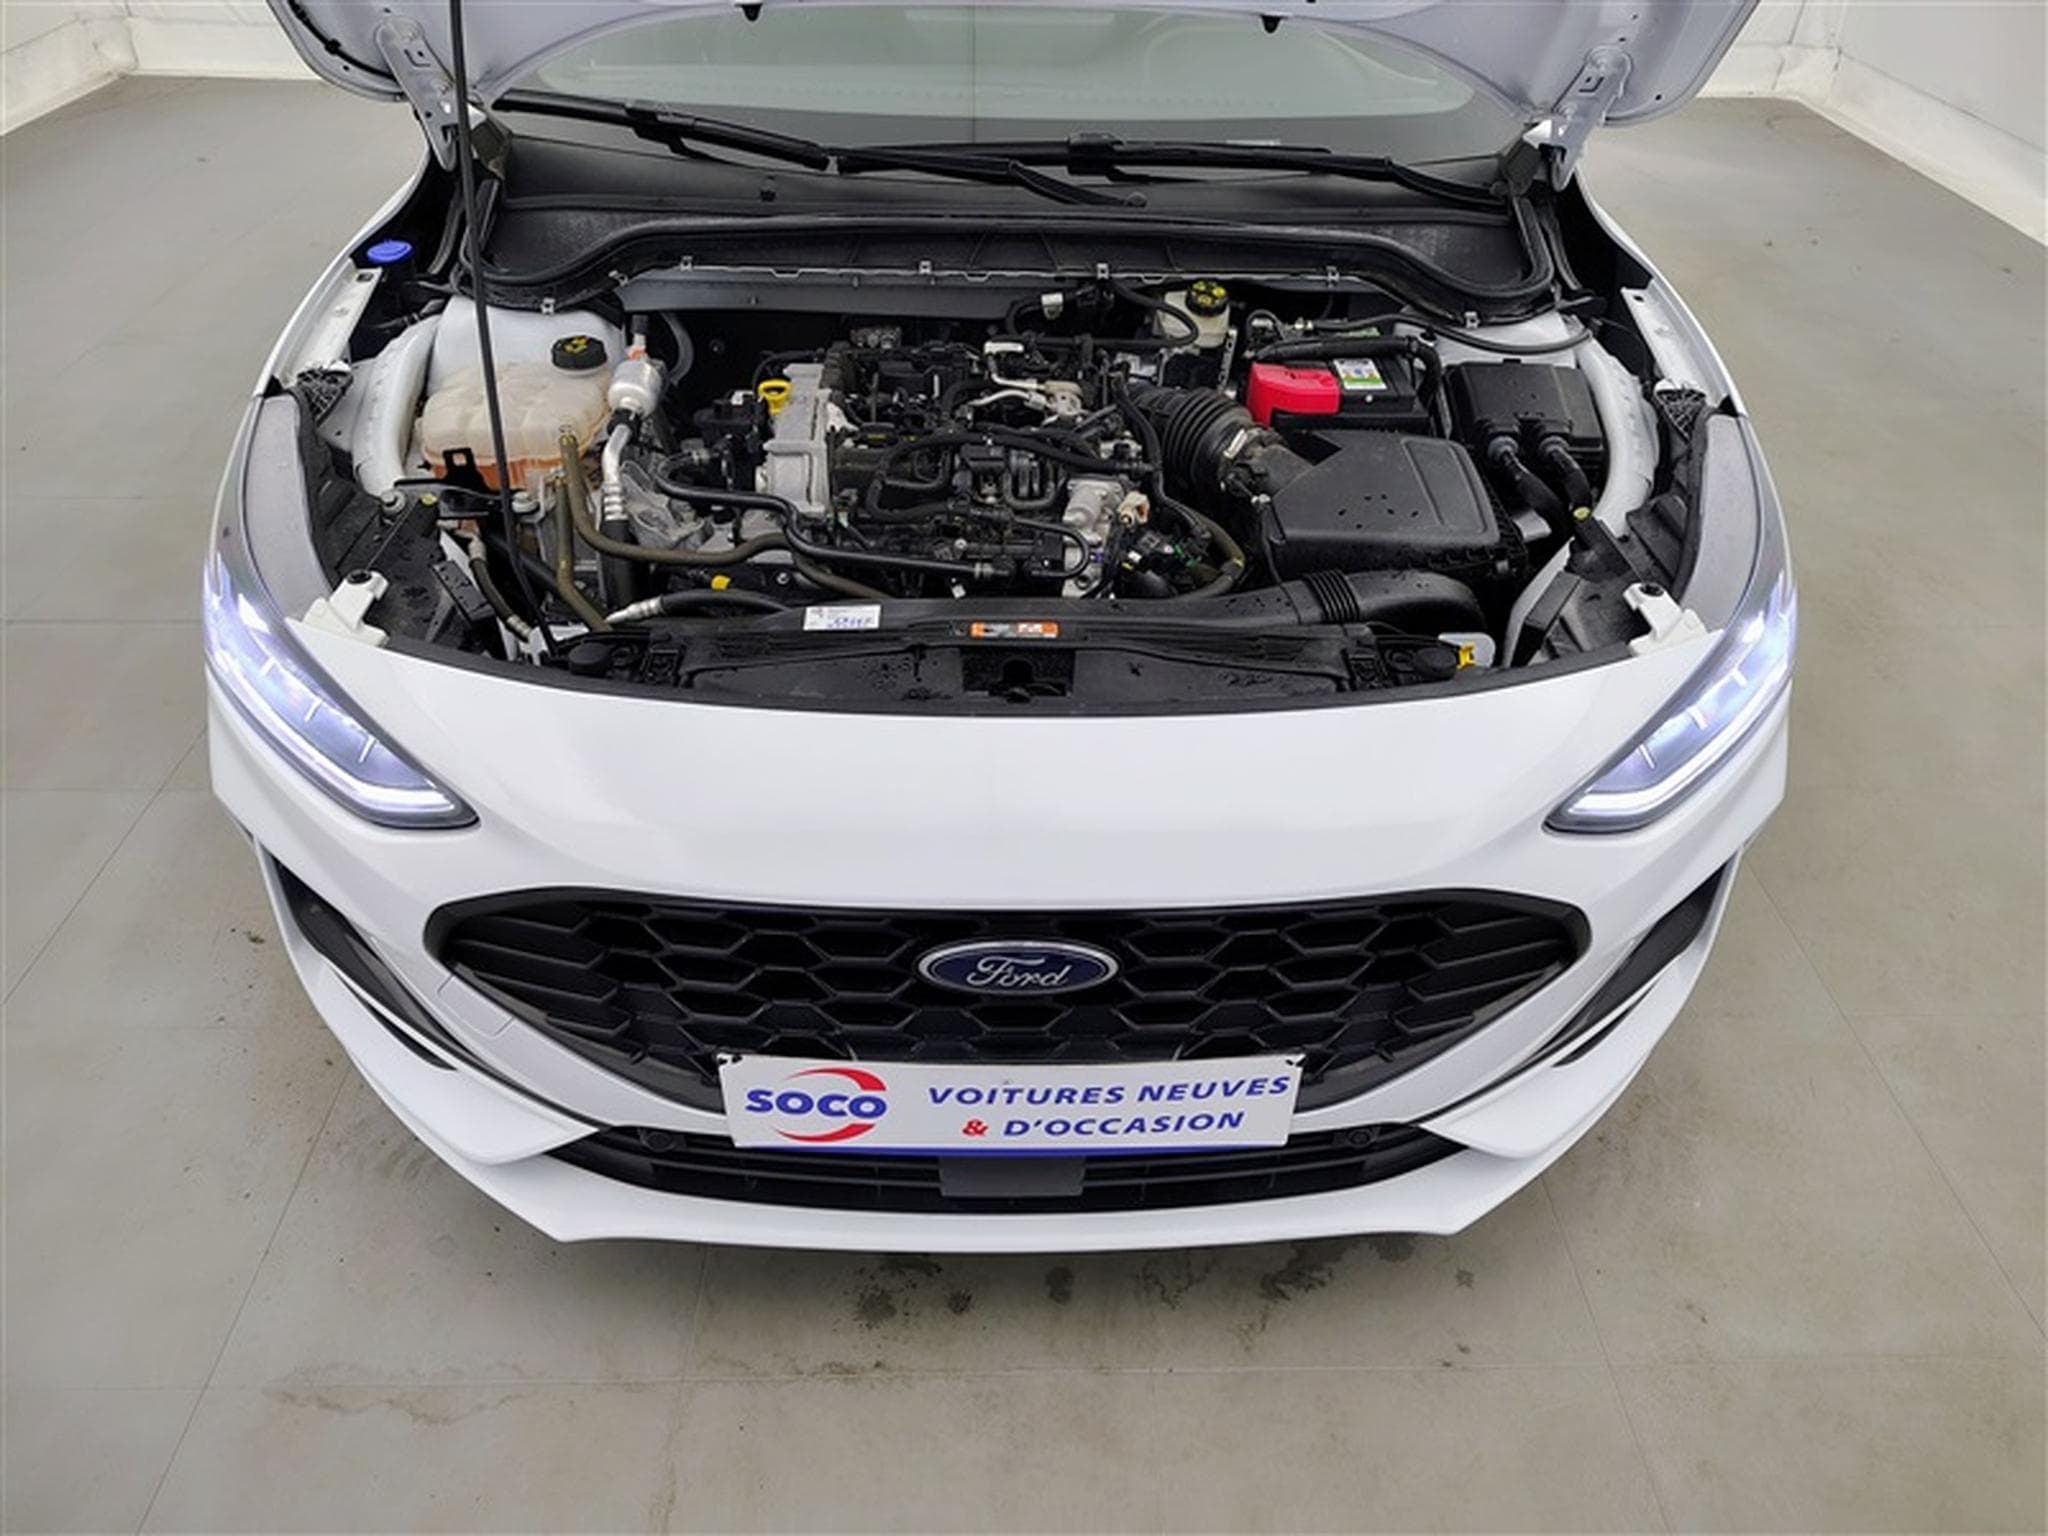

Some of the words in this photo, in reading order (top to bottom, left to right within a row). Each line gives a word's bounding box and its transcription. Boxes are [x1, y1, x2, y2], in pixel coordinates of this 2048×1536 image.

[966, 956, 1072, 987] Ford
[745, 1089, 887, 1119] SOCO
[928, 1086, 1125, 1105] VOITURES
[1137, 1076, 1291, 1102] NEUVES
[962, 1119, 988, 1136] &
[1004, 1112, 1245, 1136] D'OCCASION
